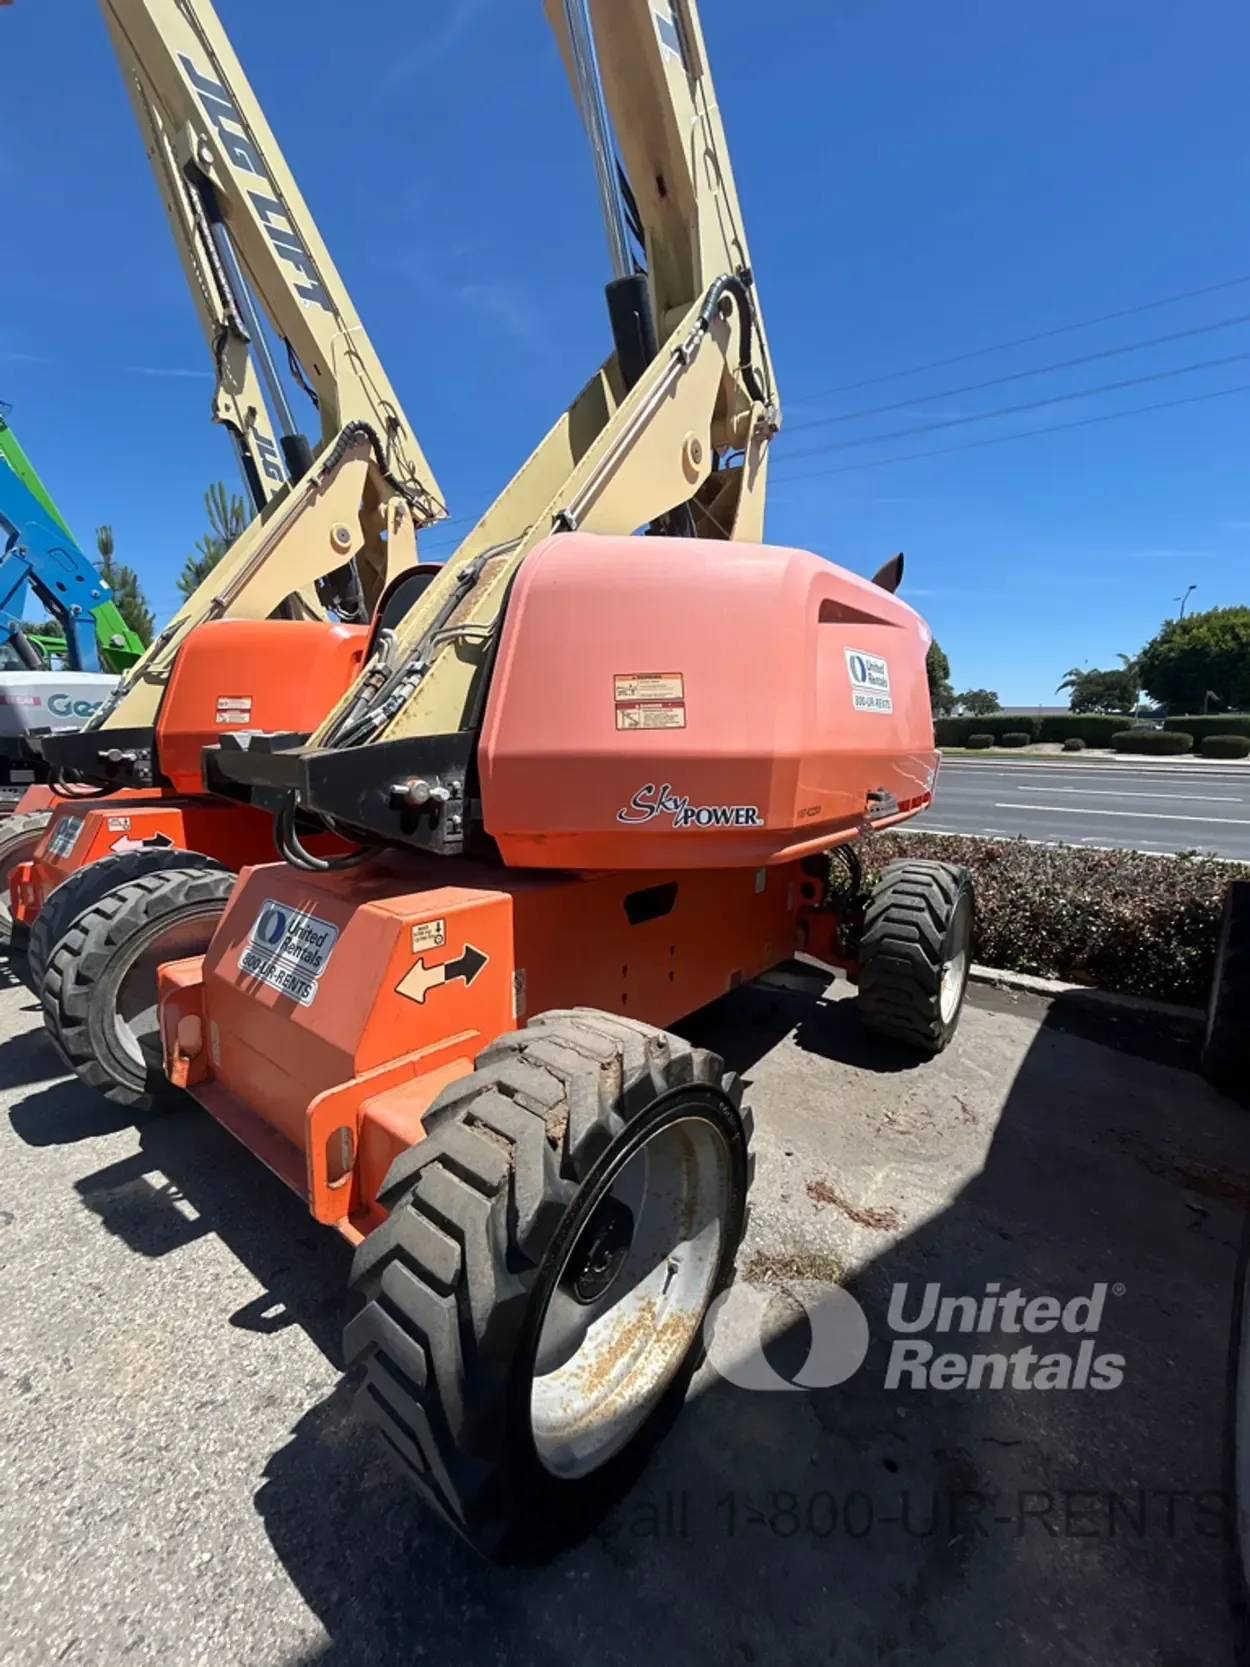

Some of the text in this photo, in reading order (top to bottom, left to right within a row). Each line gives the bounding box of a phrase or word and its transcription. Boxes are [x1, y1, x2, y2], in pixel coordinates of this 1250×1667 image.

[177, 51, 336, 316] JLG LIFT
[249, 426, 285, 484] JLG
[682, 806, 758, 827] POWER
[280, 936, 324, 967] Rentals
[288, 918, 328, 948] United
[242, 952, 312, 998] 800-UR-RENTS
